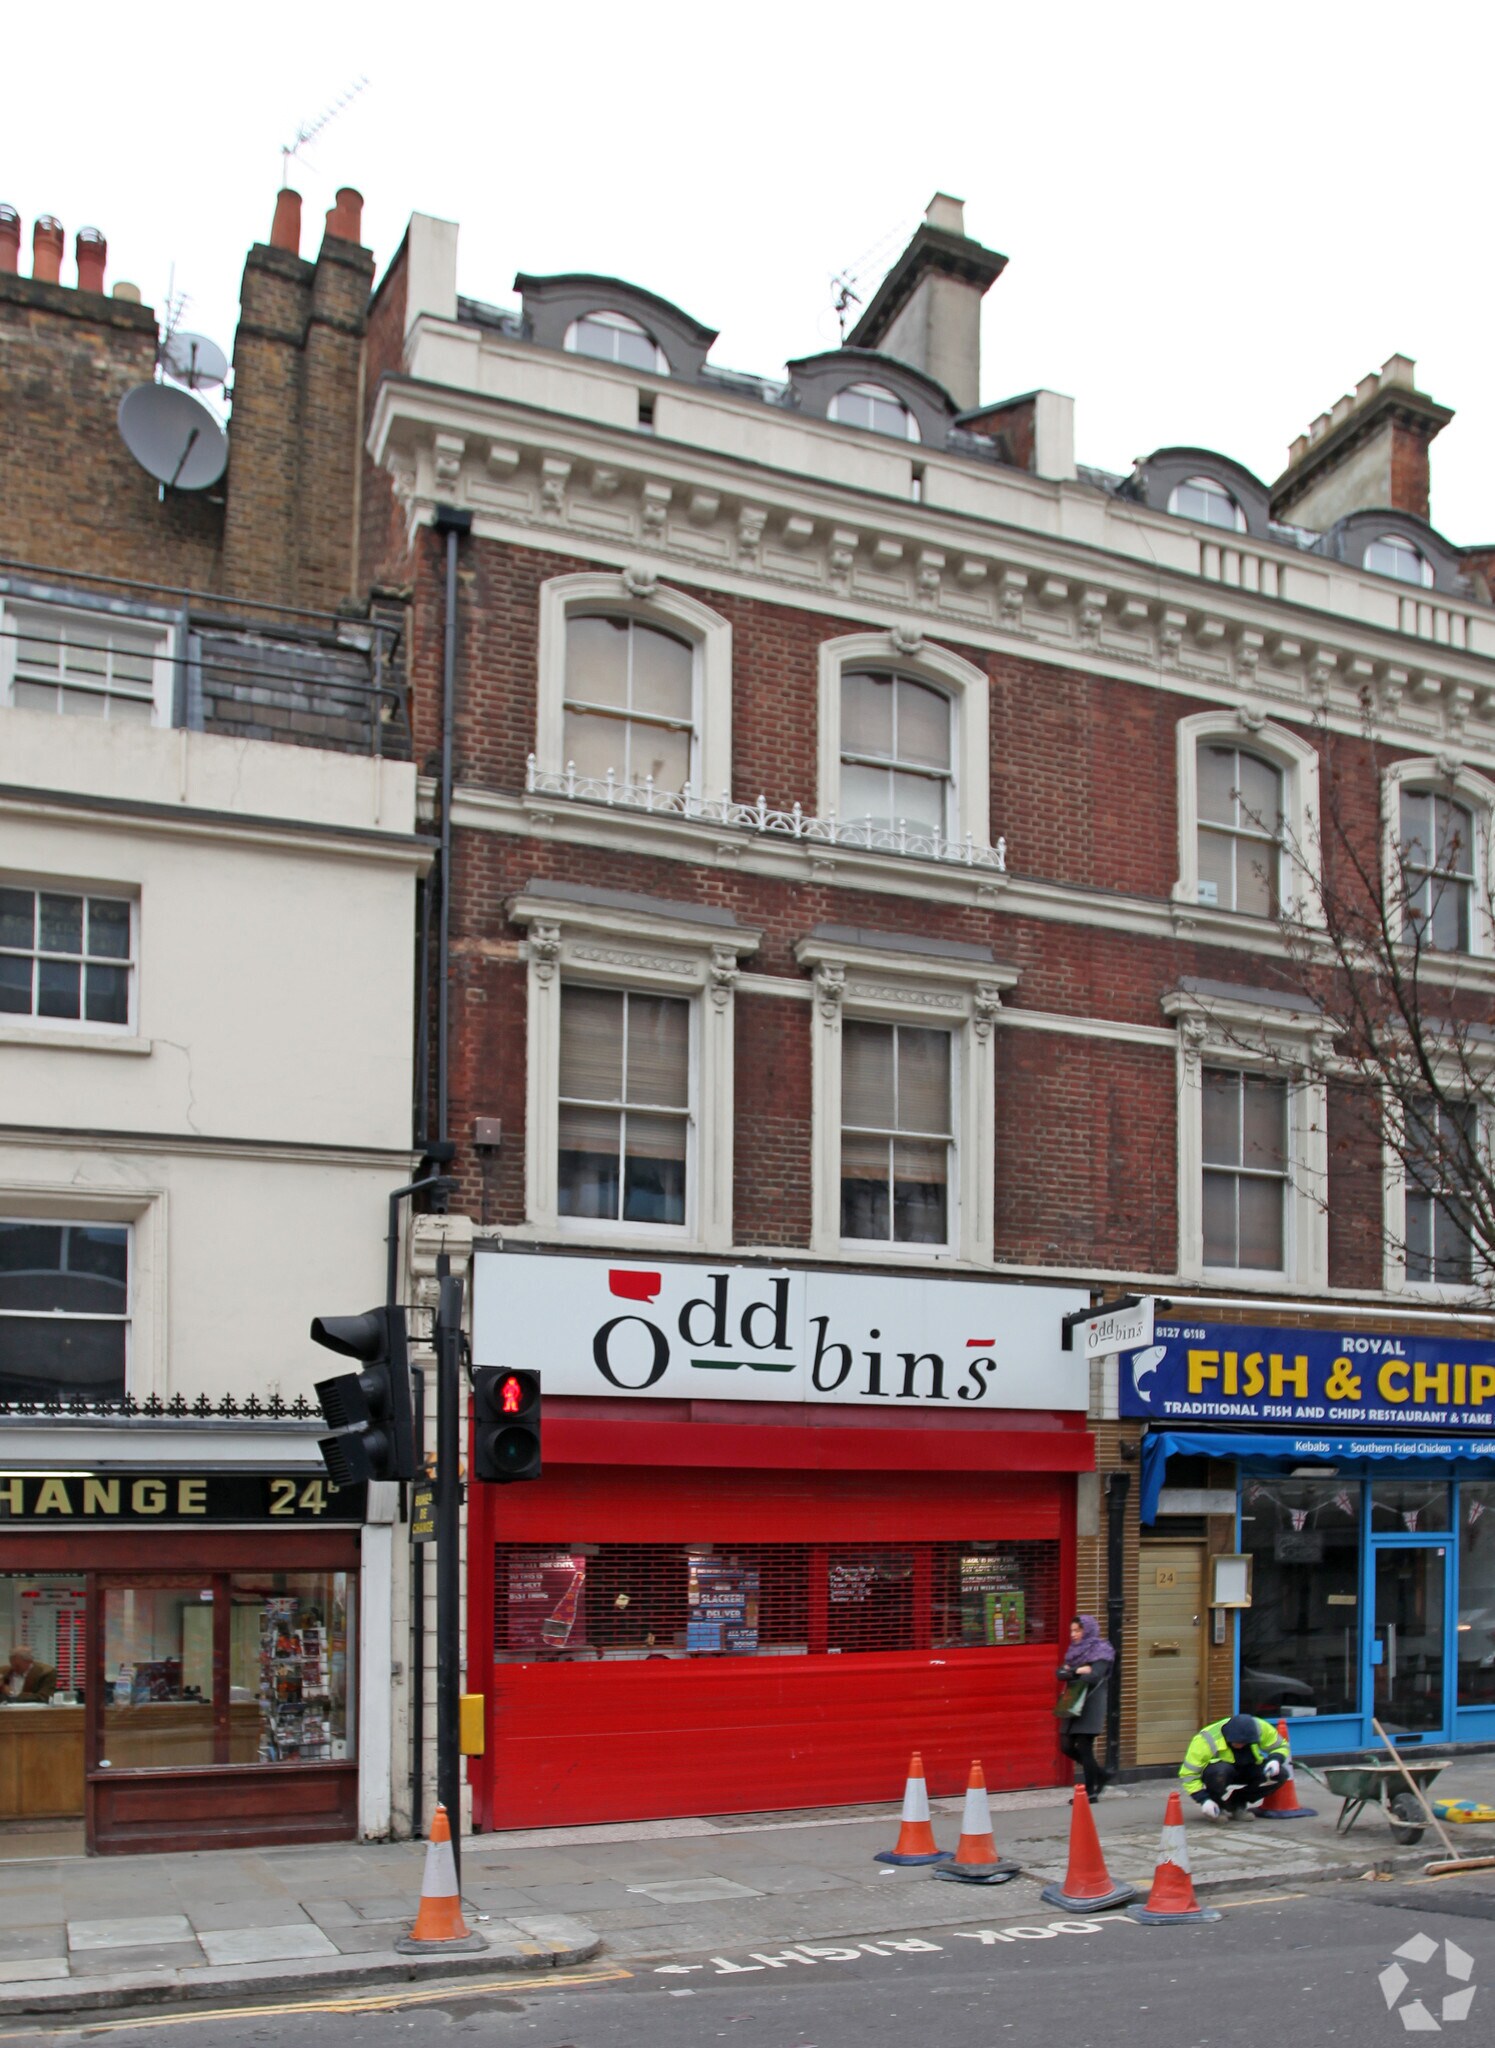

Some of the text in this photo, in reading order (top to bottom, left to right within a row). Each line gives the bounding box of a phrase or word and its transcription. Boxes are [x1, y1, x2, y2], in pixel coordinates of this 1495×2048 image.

[592, 1273, 998, 1401] Oddbins
[1088, 1318, 1144, 1349] Oddbins
[1155, 1326, 1180, 1339] 8127
[1341, 1336, 1406, 1356] ROYAL
[1187, 1349, 1495, 1406] FISH & CHIP
[1163, 1401, 1493, 1425] TRADITIONAL FISH AND CHIPS RESTAURANT & TAKE
[1295, 1441, 1331, 1452] Kebabs
[1350, 1442, 1393, 1454] Southern
[1394, 1443, 1417, 1454] Fried
[1418, 1443, 1452, 1455] Chicken
[1159, 1572, 1174, 1584] 24
[709, 1915, 1139, 1975] LOOK RIGHT
